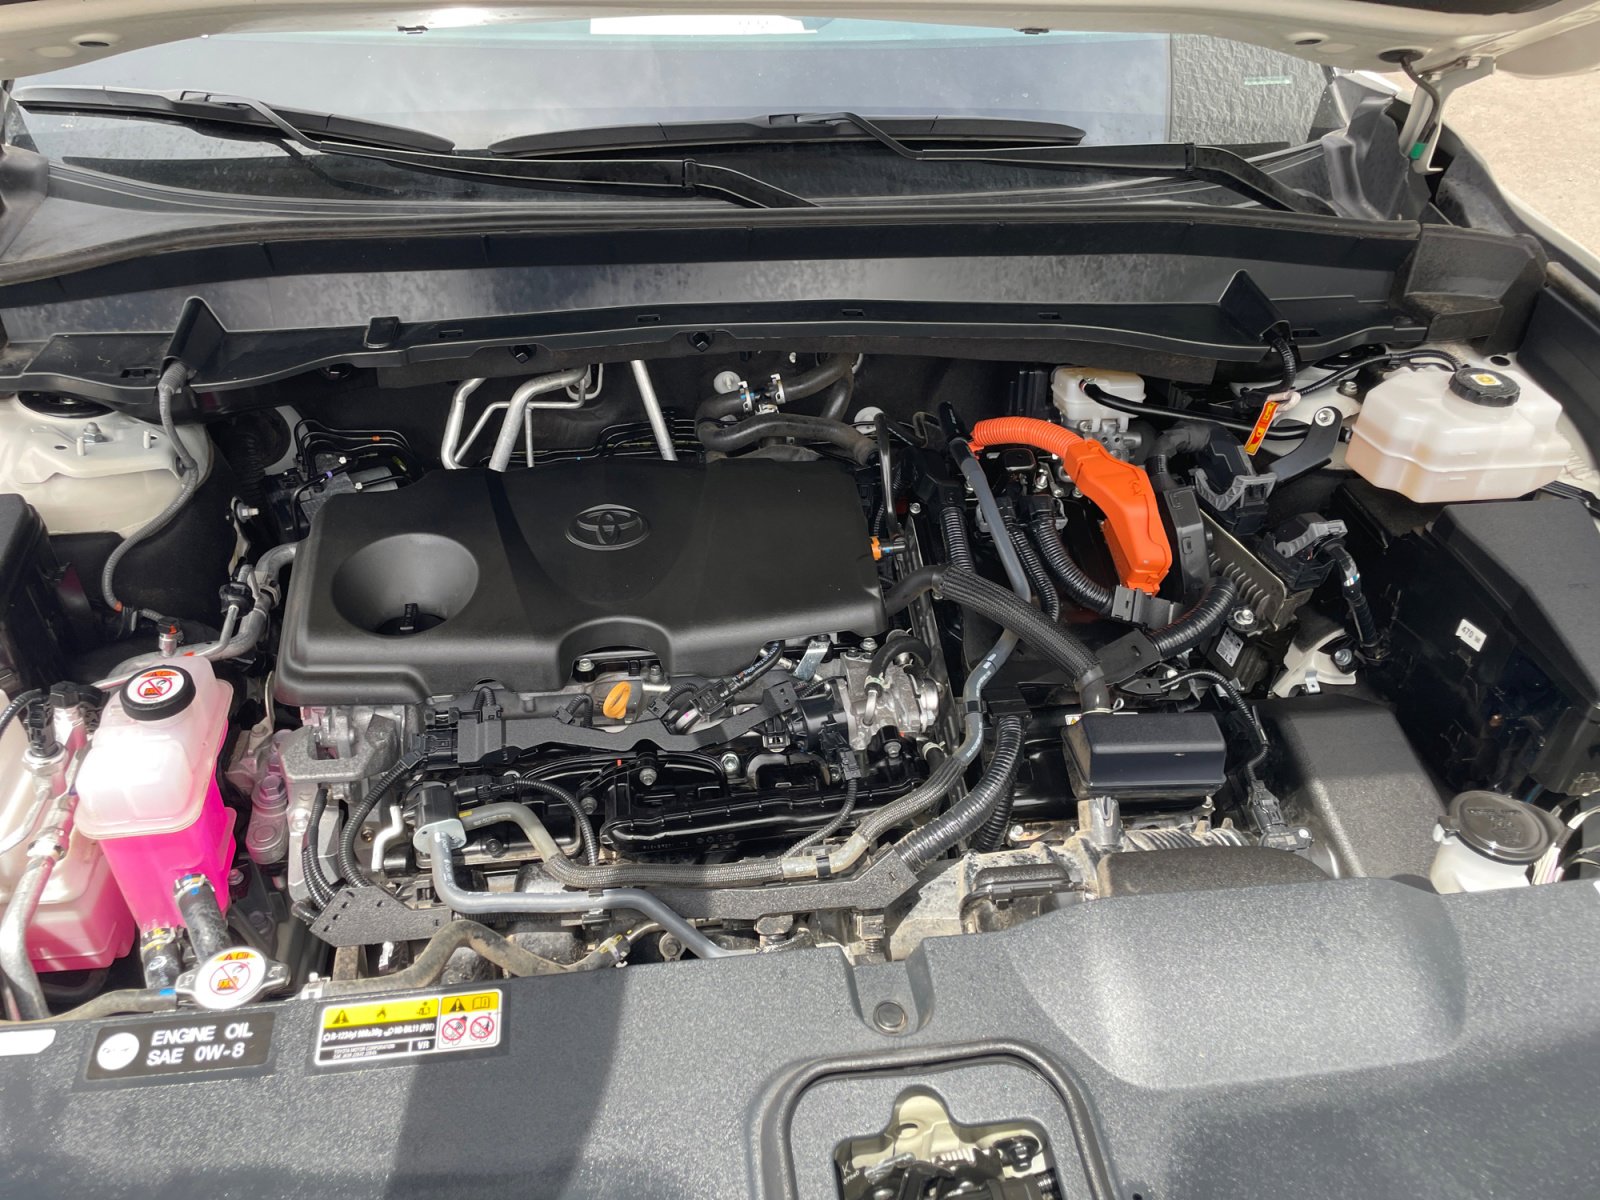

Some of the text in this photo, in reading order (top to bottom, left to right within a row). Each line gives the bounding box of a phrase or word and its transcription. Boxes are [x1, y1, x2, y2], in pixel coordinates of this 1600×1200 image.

[151, 1022, 254, 1046] ENGINE OIL
[146, 1042, 245, 1066] SAE 0W-8
